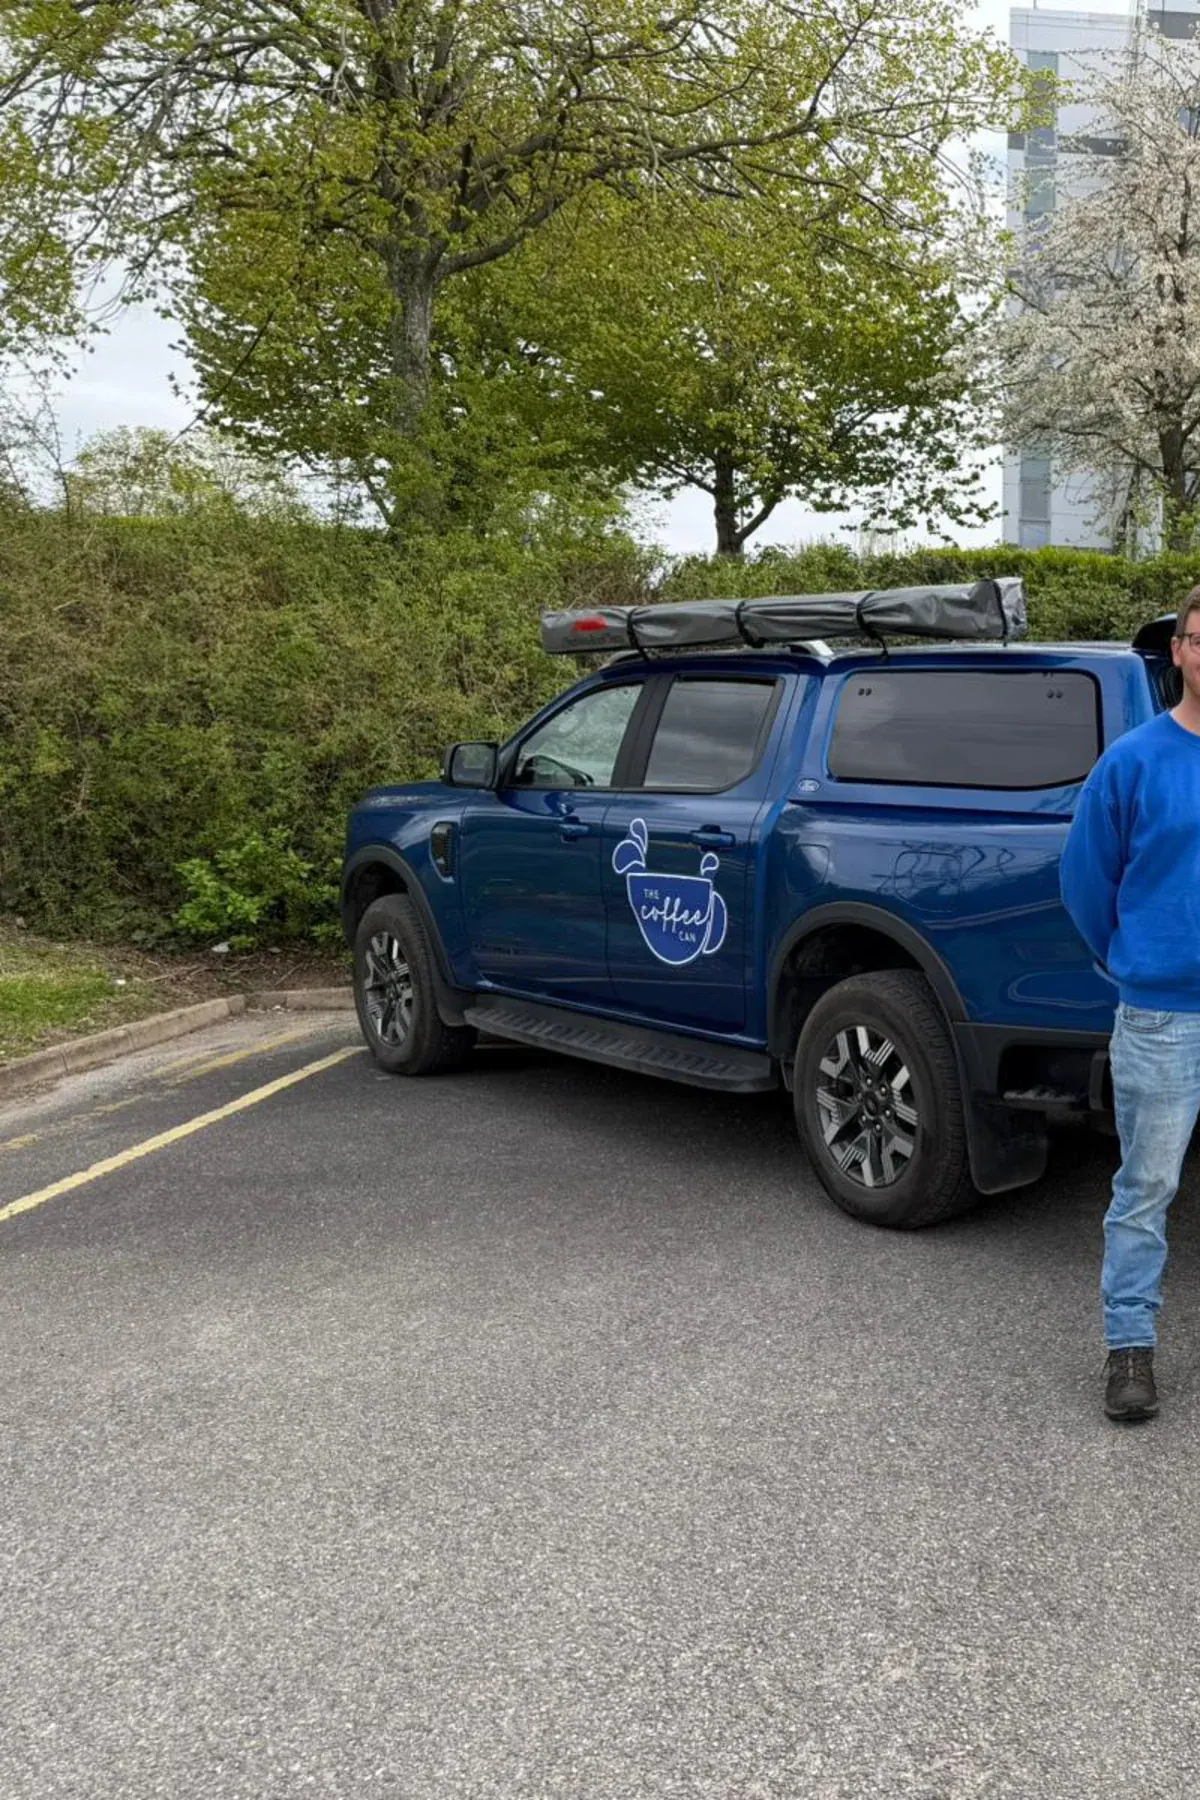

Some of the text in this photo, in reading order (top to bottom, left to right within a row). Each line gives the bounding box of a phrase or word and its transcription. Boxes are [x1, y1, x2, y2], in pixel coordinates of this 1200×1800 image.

[643, 887, 660, 900] THE
[641, 896, 709, 933] coffee
[678, 930, 697, 943] CAN
